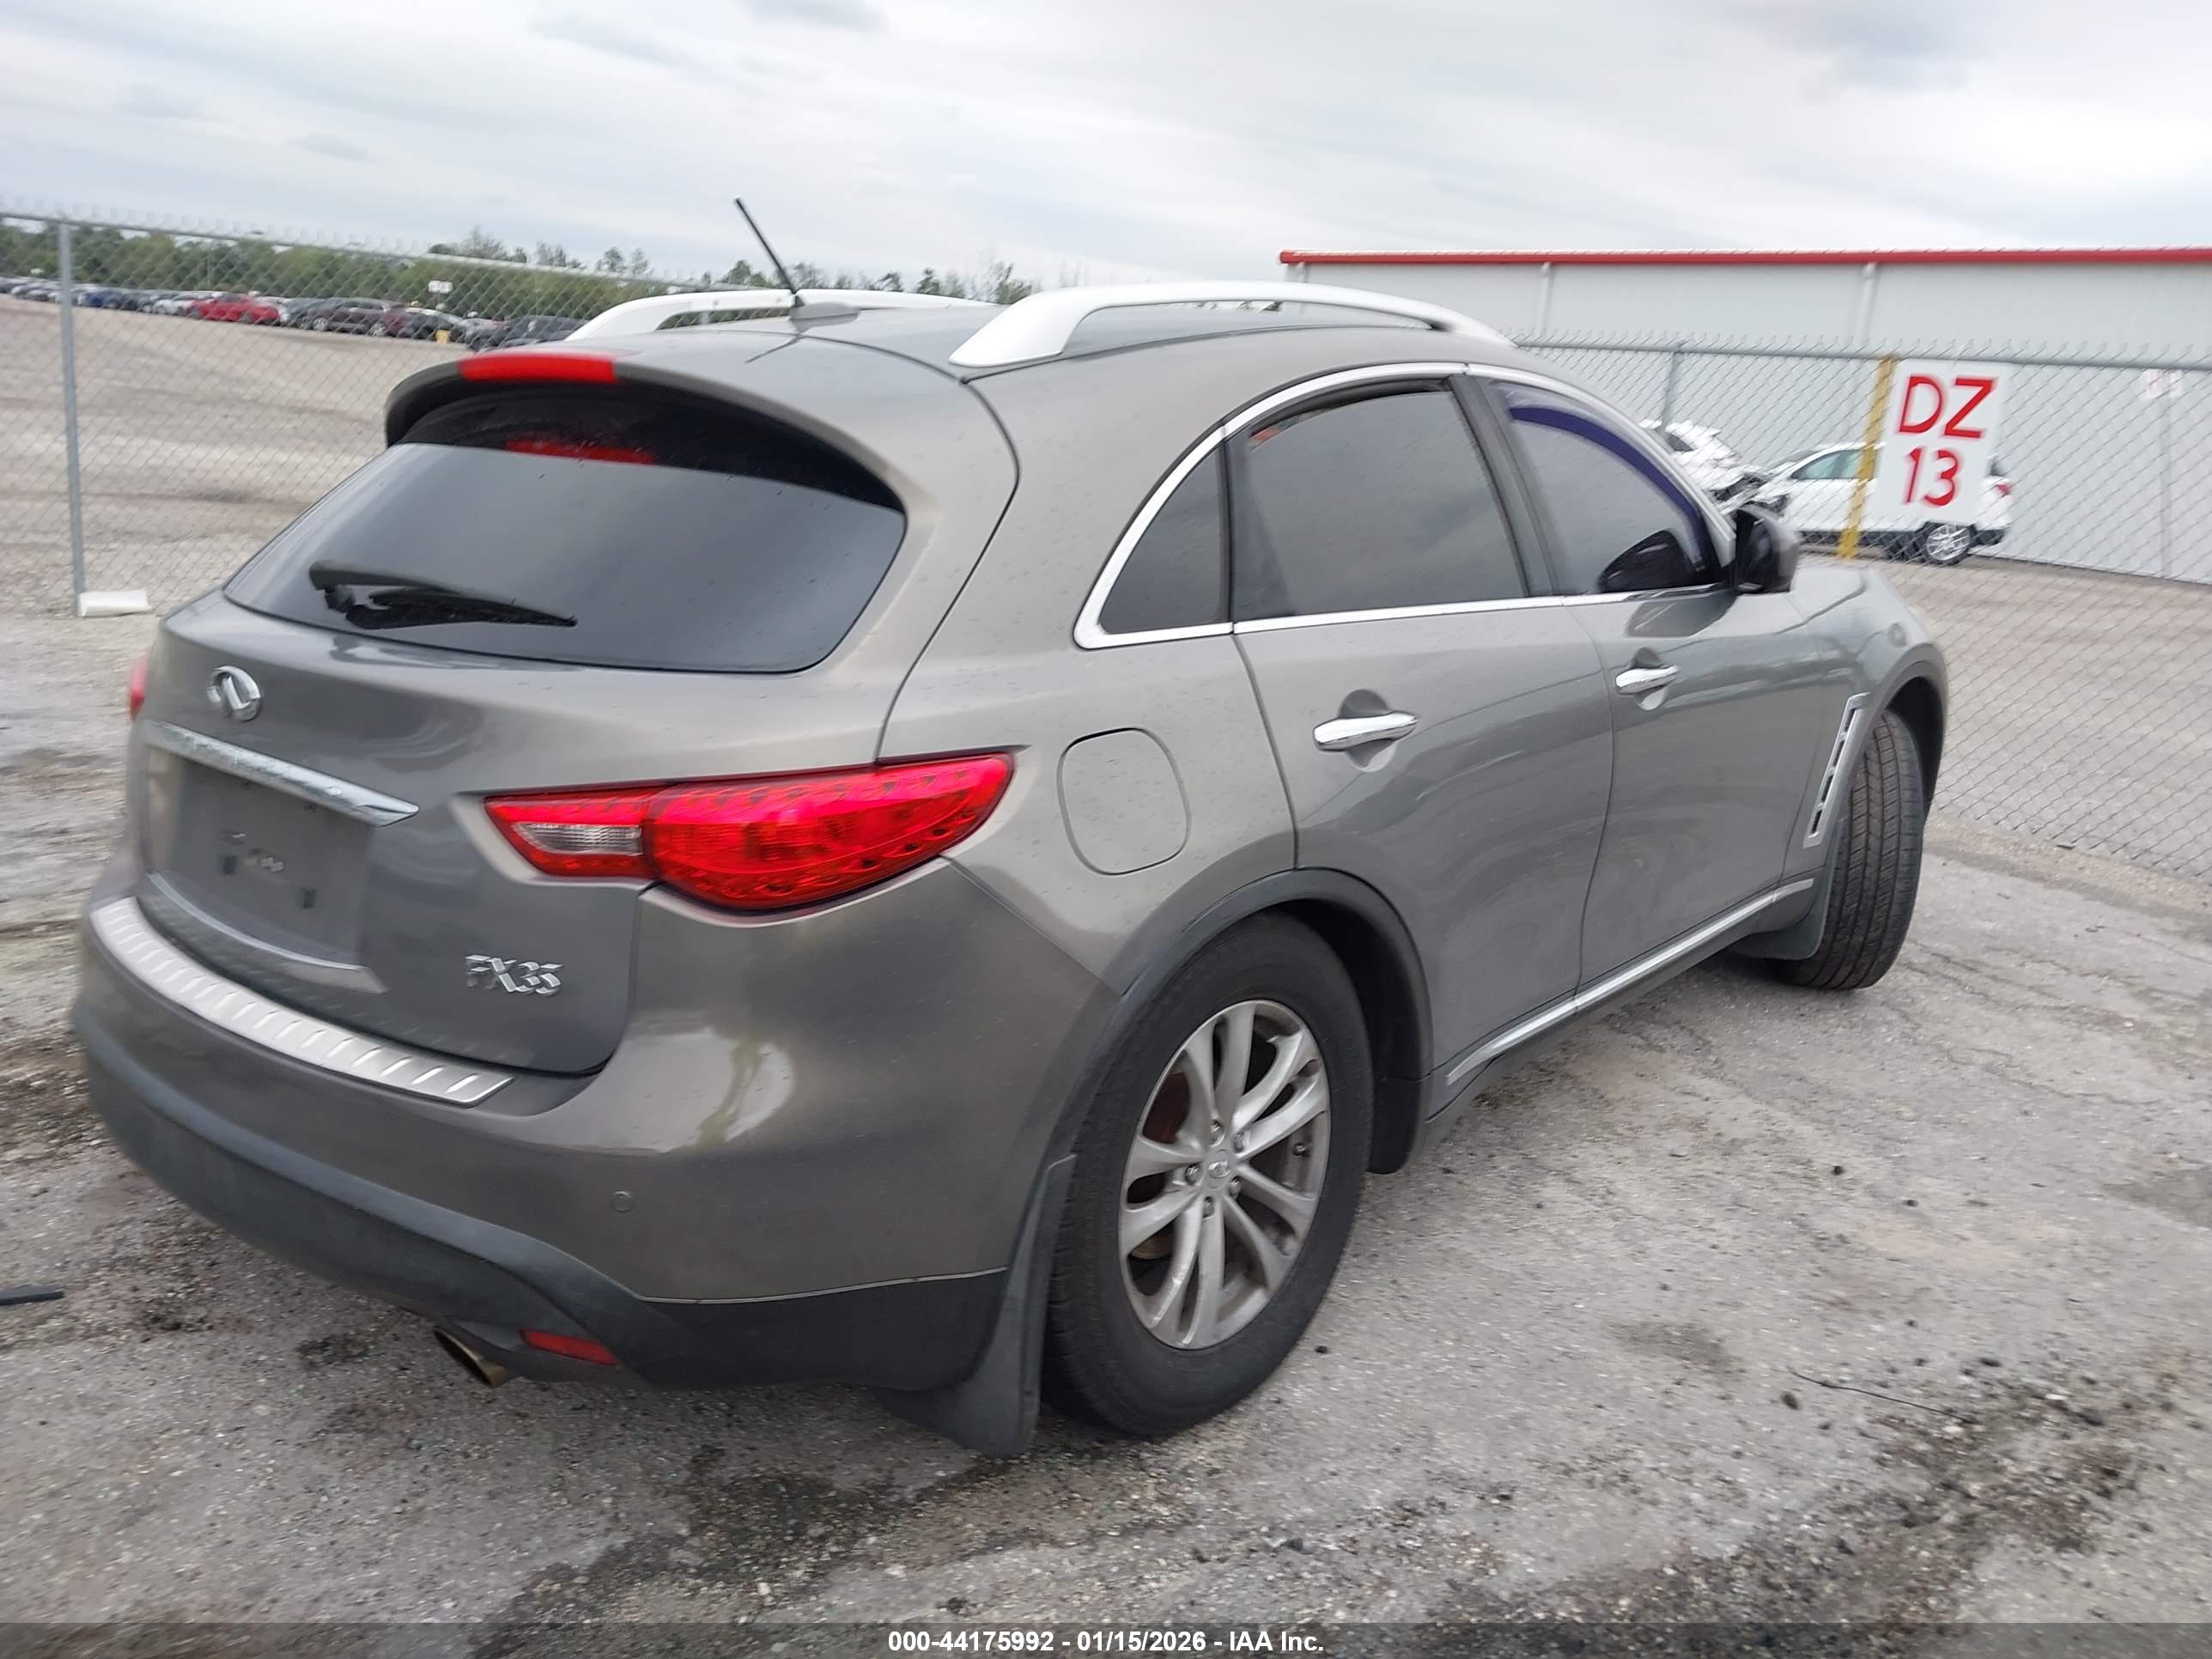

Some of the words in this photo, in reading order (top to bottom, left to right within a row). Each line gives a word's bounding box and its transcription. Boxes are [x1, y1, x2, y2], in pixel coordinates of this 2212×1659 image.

[1899, 375, 1994, 439] DZ
[1906, 447, 1960, 507] 13
[465, 954, 563, 995] FX35
